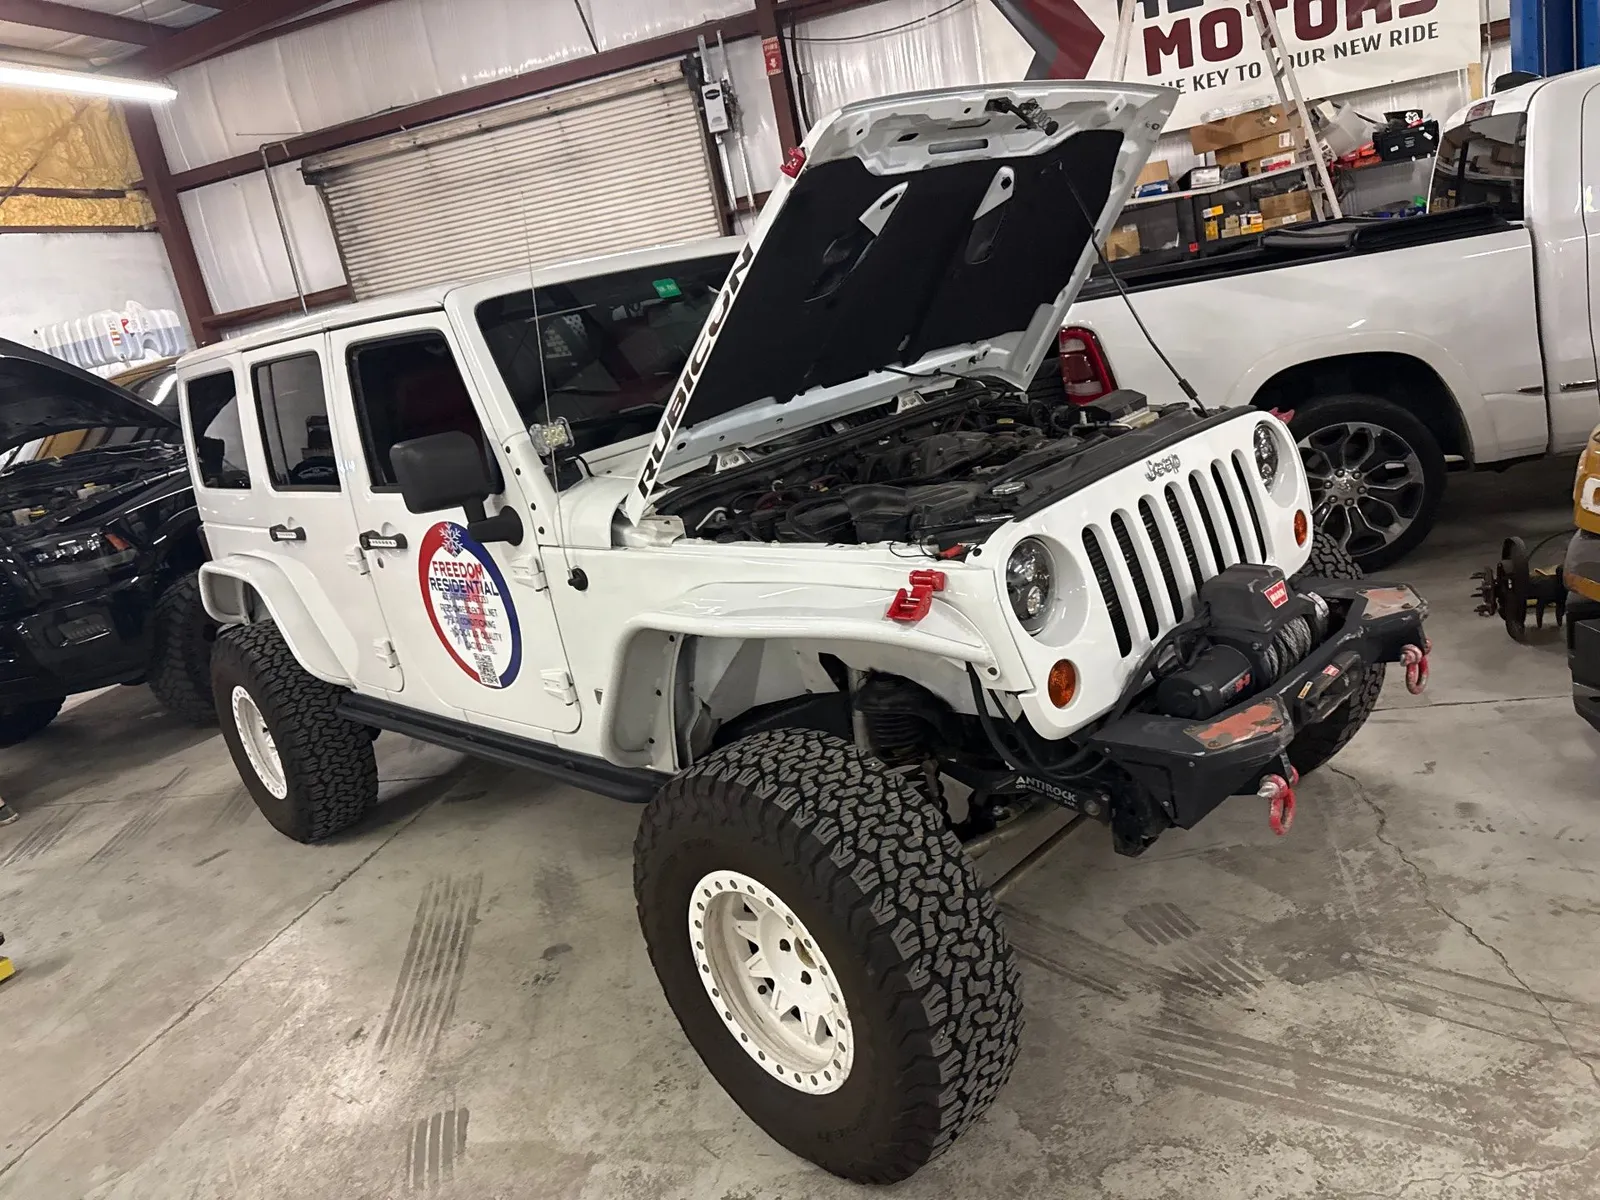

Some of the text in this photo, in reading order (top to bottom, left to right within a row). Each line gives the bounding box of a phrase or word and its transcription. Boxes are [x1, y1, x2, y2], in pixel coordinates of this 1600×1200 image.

[1193, 68, 1229, 92] KEY
[1235, 61, 1262, 82] TO
[1333, 33, 1382, 59] NEW
[1389, 22, 1439, 47] RIDE
[638, 241, 754, 500] RUBICON
[1145, 453, 1181, 482] Jeep
[432, 561, 485, 580] FREEDOM
[429, 577, 500, 596] RESIDENTIAL
[1016, 775, 1078, 802] ANTIROCK
